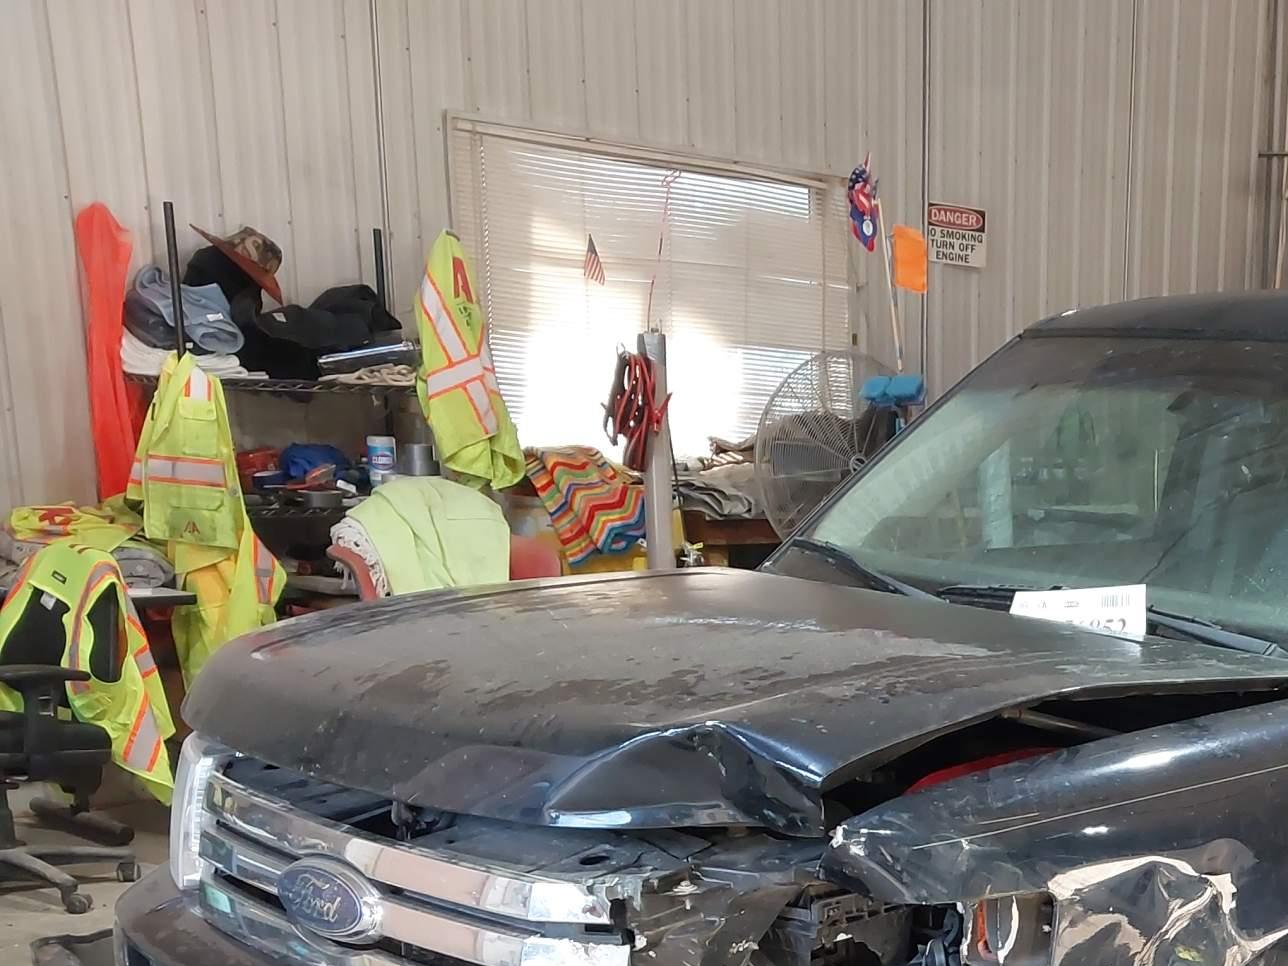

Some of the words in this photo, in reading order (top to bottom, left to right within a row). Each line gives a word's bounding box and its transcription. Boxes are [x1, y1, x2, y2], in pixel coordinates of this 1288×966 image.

[931, 208, 977, 226] DANGER
[940, 229, 984, 244] SMOKING
[930, 239, 955, 251] TURN
[958, 242, 977, 254] OFF
[935, 250, 971, 264] ENGINE
[293, 873, 343, 923] Ford
